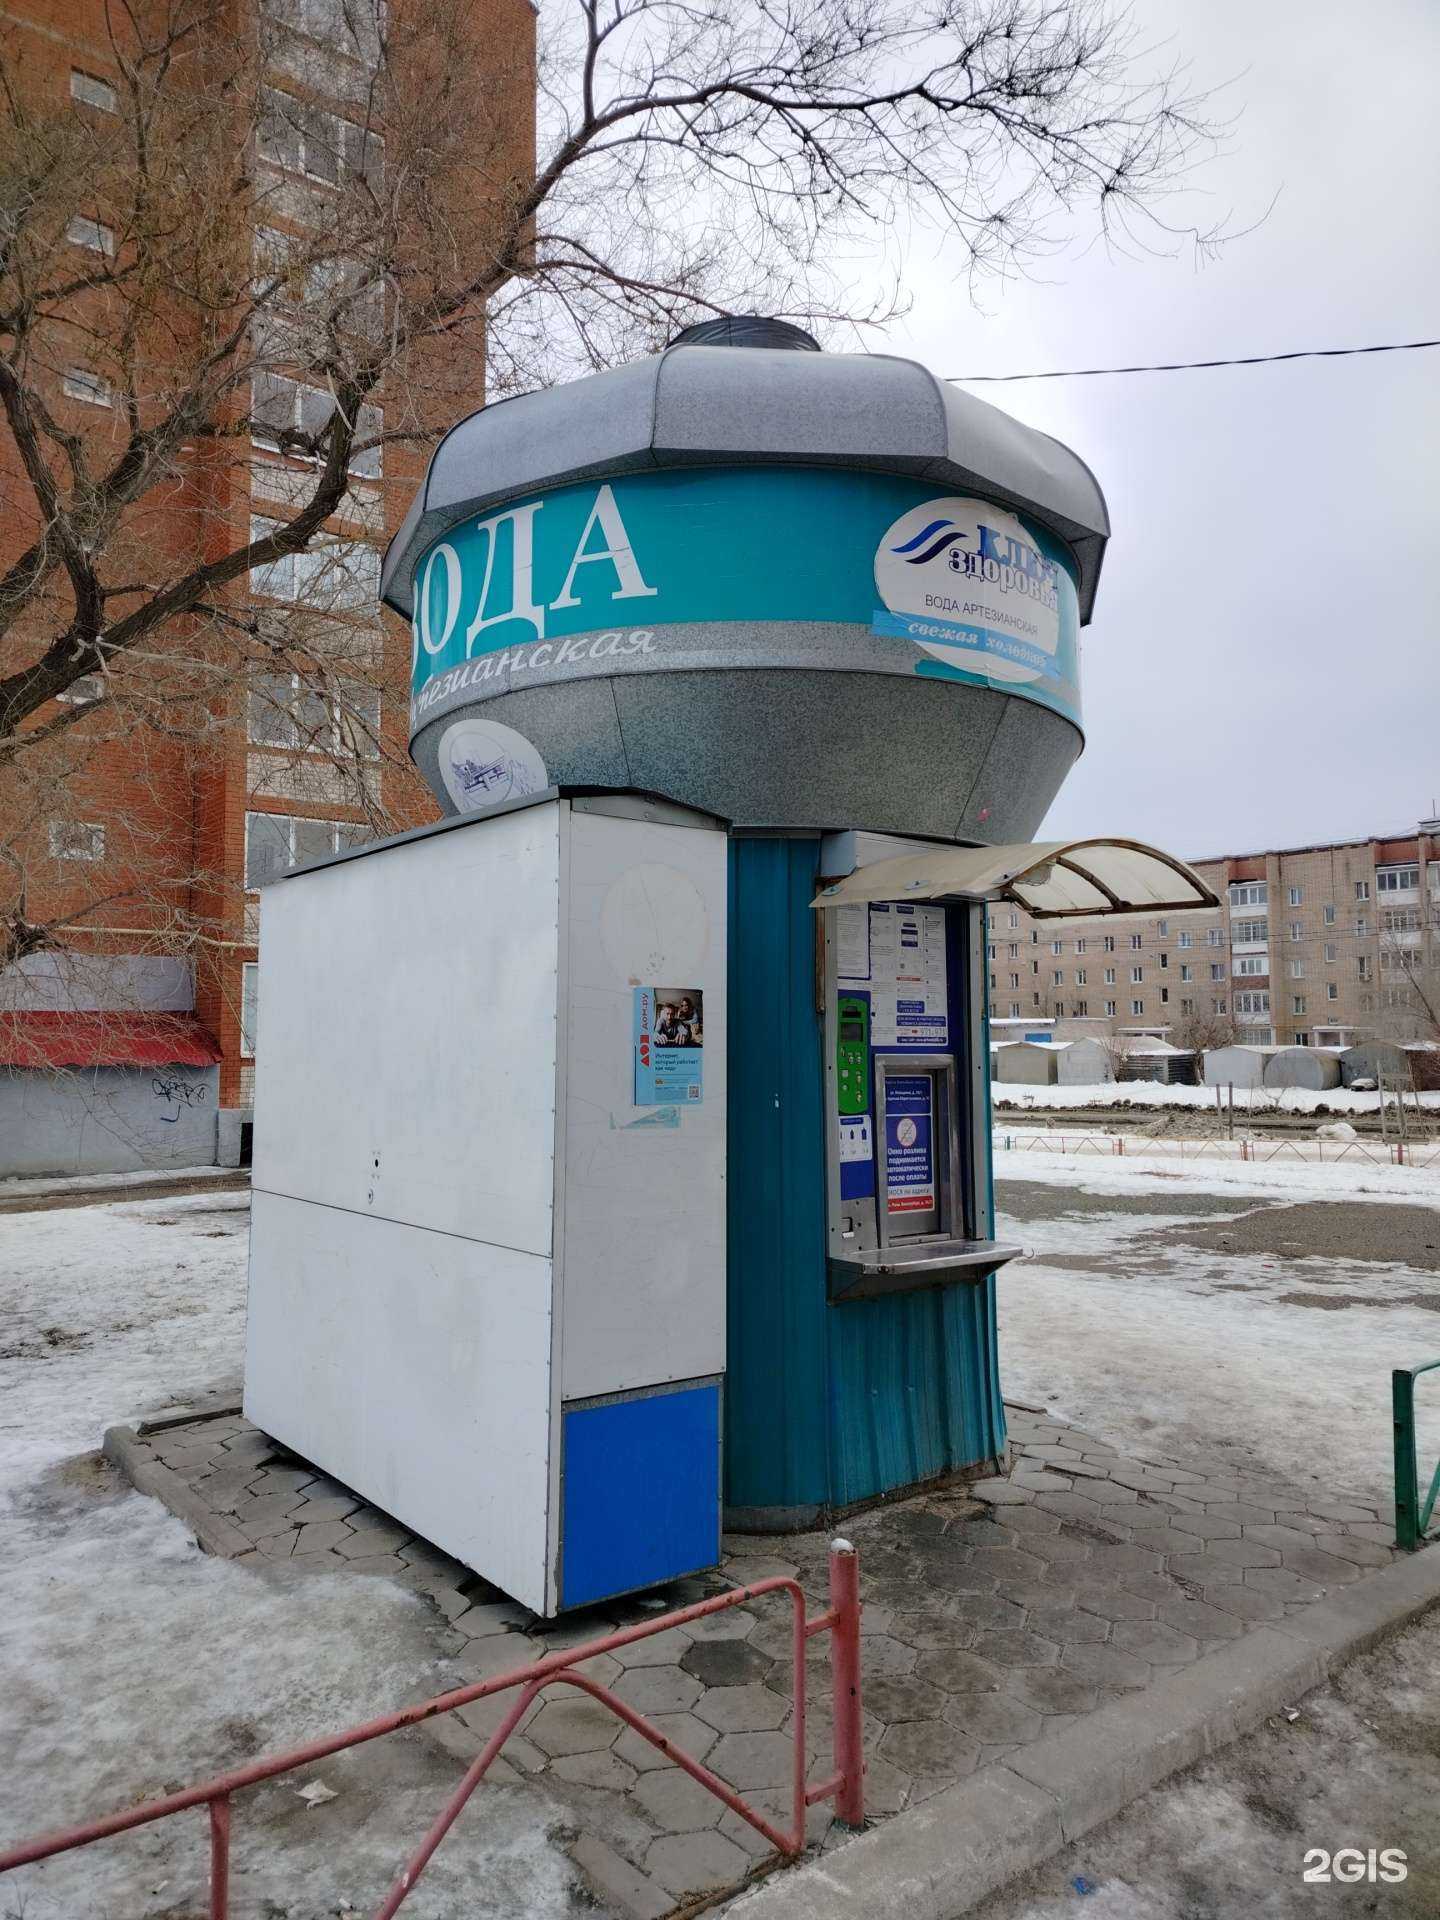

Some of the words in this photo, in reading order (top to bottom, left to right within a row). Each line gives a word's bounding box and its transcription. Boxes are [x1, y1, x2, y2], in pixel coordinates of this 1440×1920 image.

[411, 483, 659, 678] ОДА
[925, 594, 960, 614] ВОДА
[962, 602, 1039, 635] АРТЕЗИАНСКАЯ
[908, 622, 979, 645] свежая
[411, 630, 658, 729] тезианская
